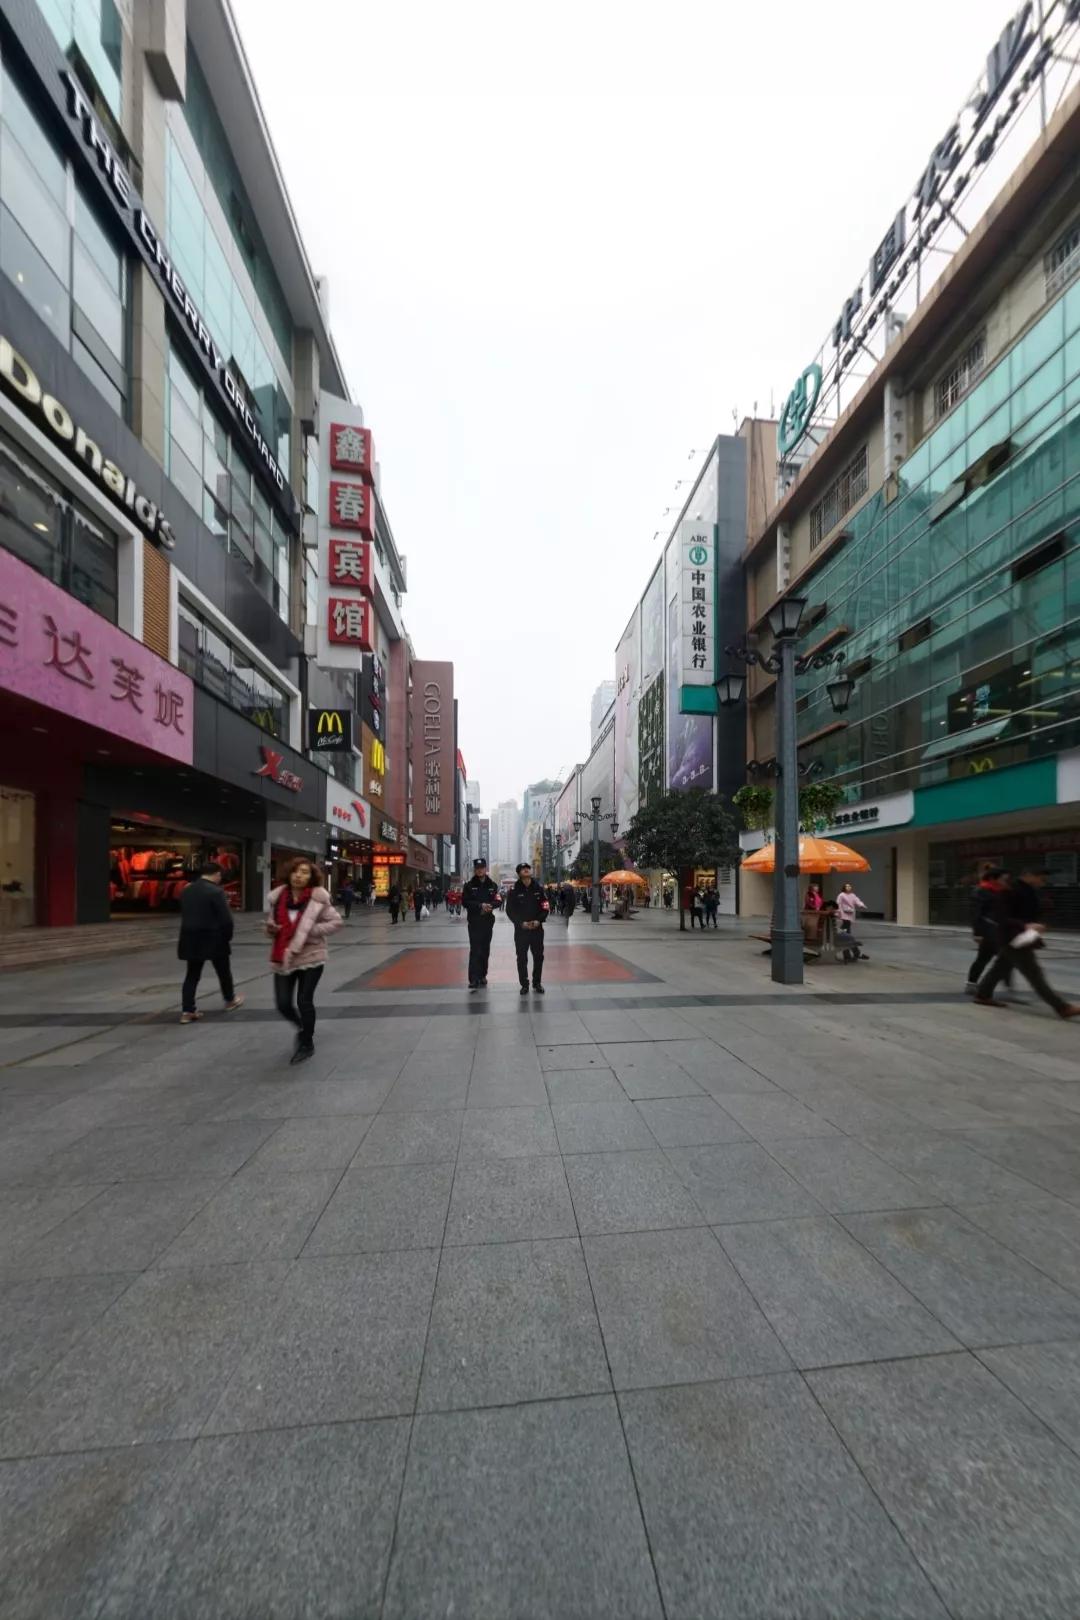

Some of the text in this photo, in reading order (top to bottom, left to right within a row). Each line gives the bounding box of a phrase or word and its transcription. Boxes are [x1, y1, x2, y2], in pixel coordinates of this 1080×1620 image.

[61, 70, 284, 490] THE CHERRY ORCHARD
[333, 427, 365, 638] 鑫春宾馆
[690, 535, 707, 543] ABC
[691, 569, 707, 669] 中国农业银行
[424, 681, 441, 757] GOELIA
